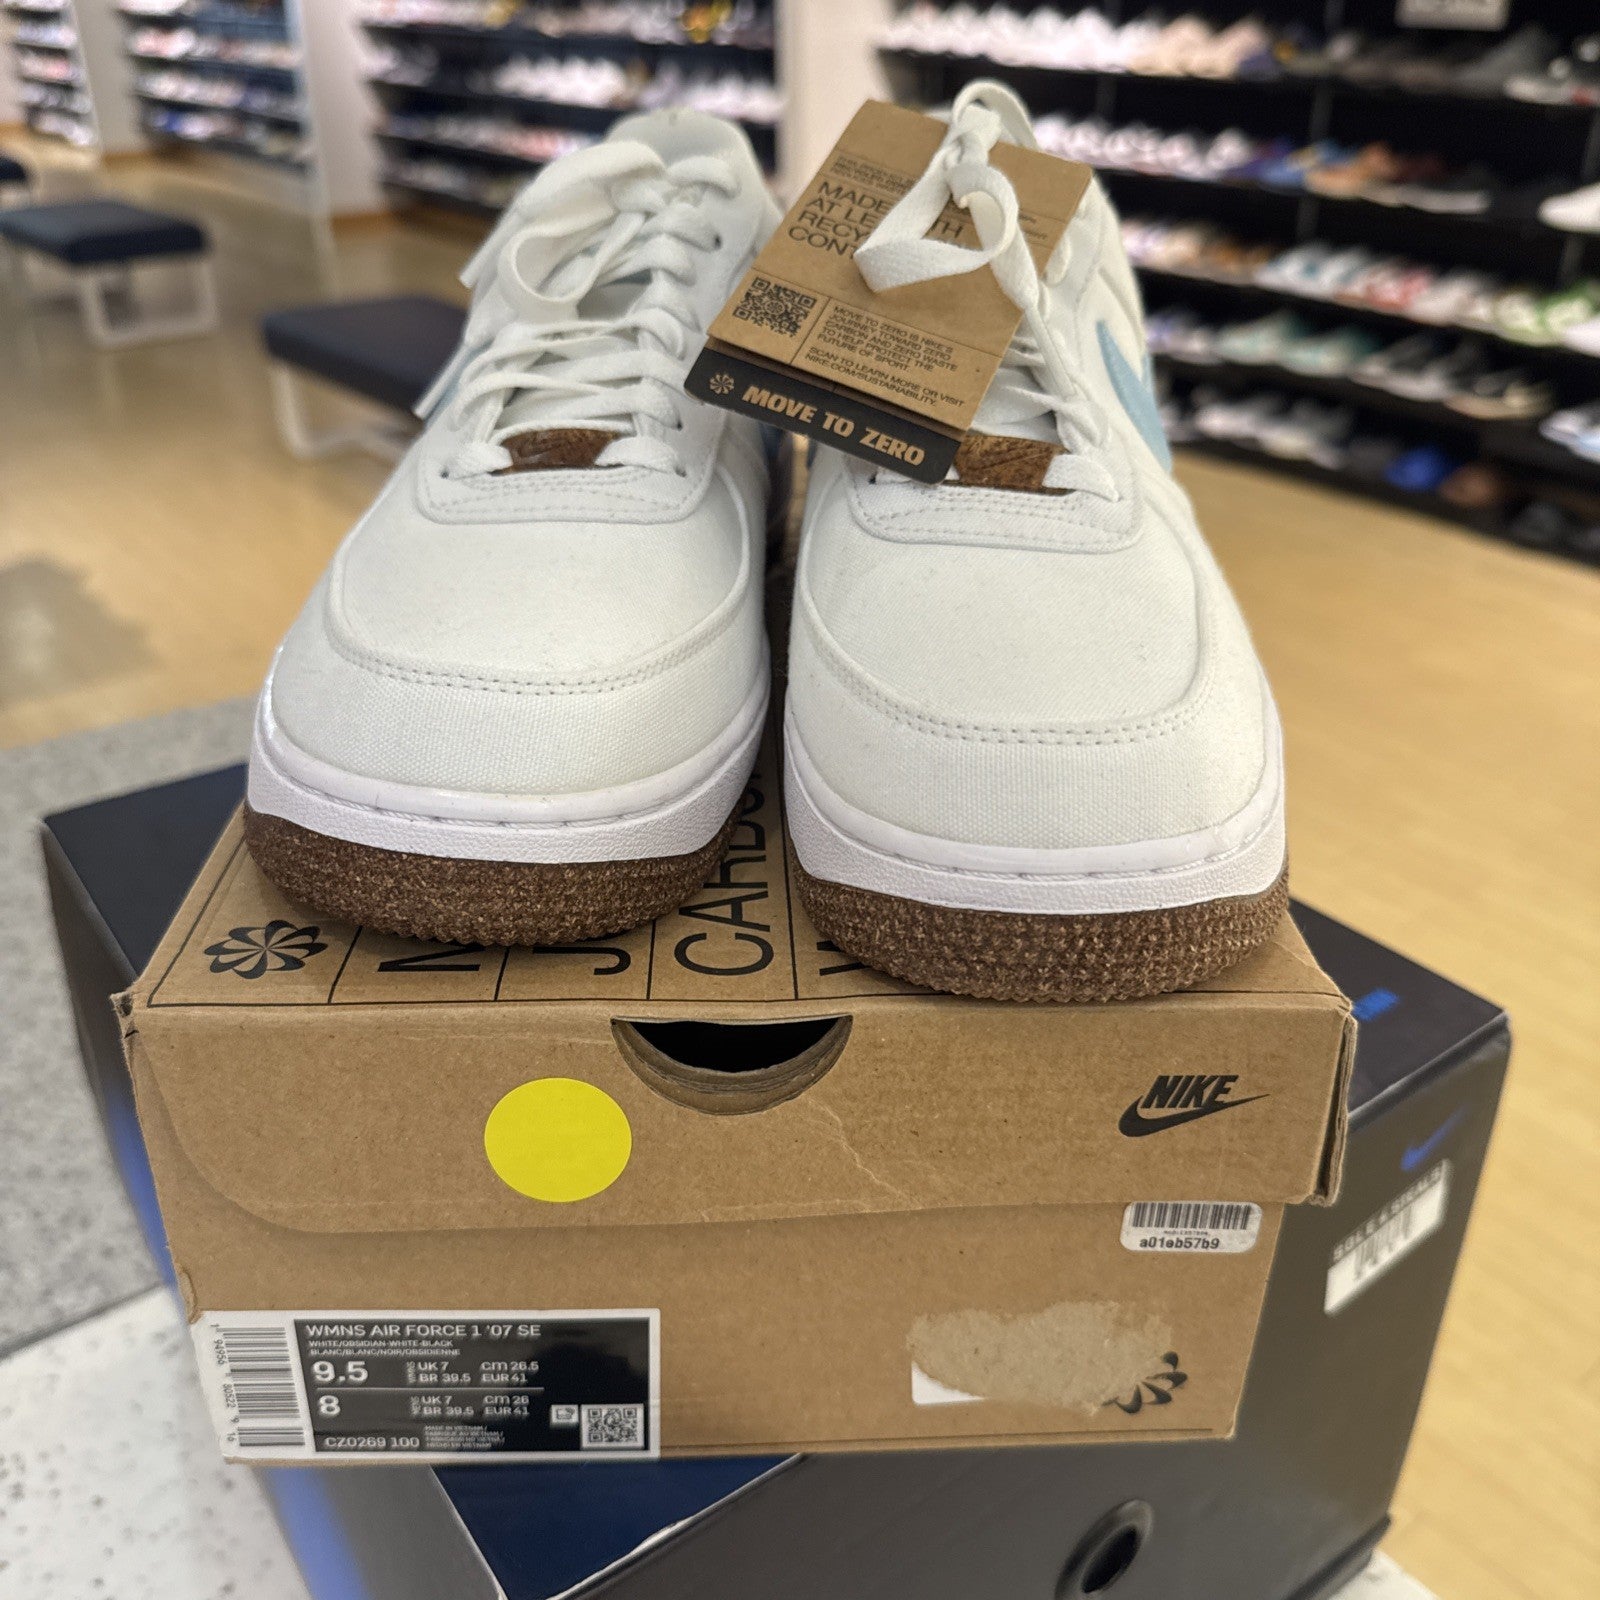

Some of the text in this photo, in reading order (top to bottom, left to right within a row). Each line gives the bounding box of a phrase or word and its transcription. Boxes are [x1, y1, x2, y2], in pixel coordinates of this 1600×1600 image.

[805, 198, 842, 213] AT
[818, 181, 892, 215] MADE
[797, 210, 872, 243] RECY
[829, 314, 952, 361] JOURNEY TOWARD ZERO
[834, 306, 954, 355] MOVE TO ZERO IS NIKE'S
[817, 333, 910, 373] FUTURE OF SPORT.
[822, 328, 934, 373] TO HELP PROTECT THE
[825, 320, 958, 371] CARBON AND ZERO WASTE
[810, 347, 965, 407] SCAN TO LEARN MORE OR VISIT
[742, 385, 926, 467] MOVE TO ZERO
[1141, 1074, 1239, 1109] NIKE
[306, 1324, 541, 1336] WMNS AIR FORCE 1 '07 SE
[313, 1361, 368, 1382] 9.5
[418, 1361, 449, 1371] UK 7
[510, 1361, 539, 1371] 26.5
[419, 1373, 438, 1382] BR
[481, 1373, 527, 1382] EUR 41
[318, 1395, 341, 1415] 8
[421, 1395, 453, 1404] UK 7
[423, 1406, 442, 1415] BR
[484, 1406, 530, 1415] EUR 41
[324, 1436, 387, 1448] CZ0269
[390, 1437, 420, 1447] 100
